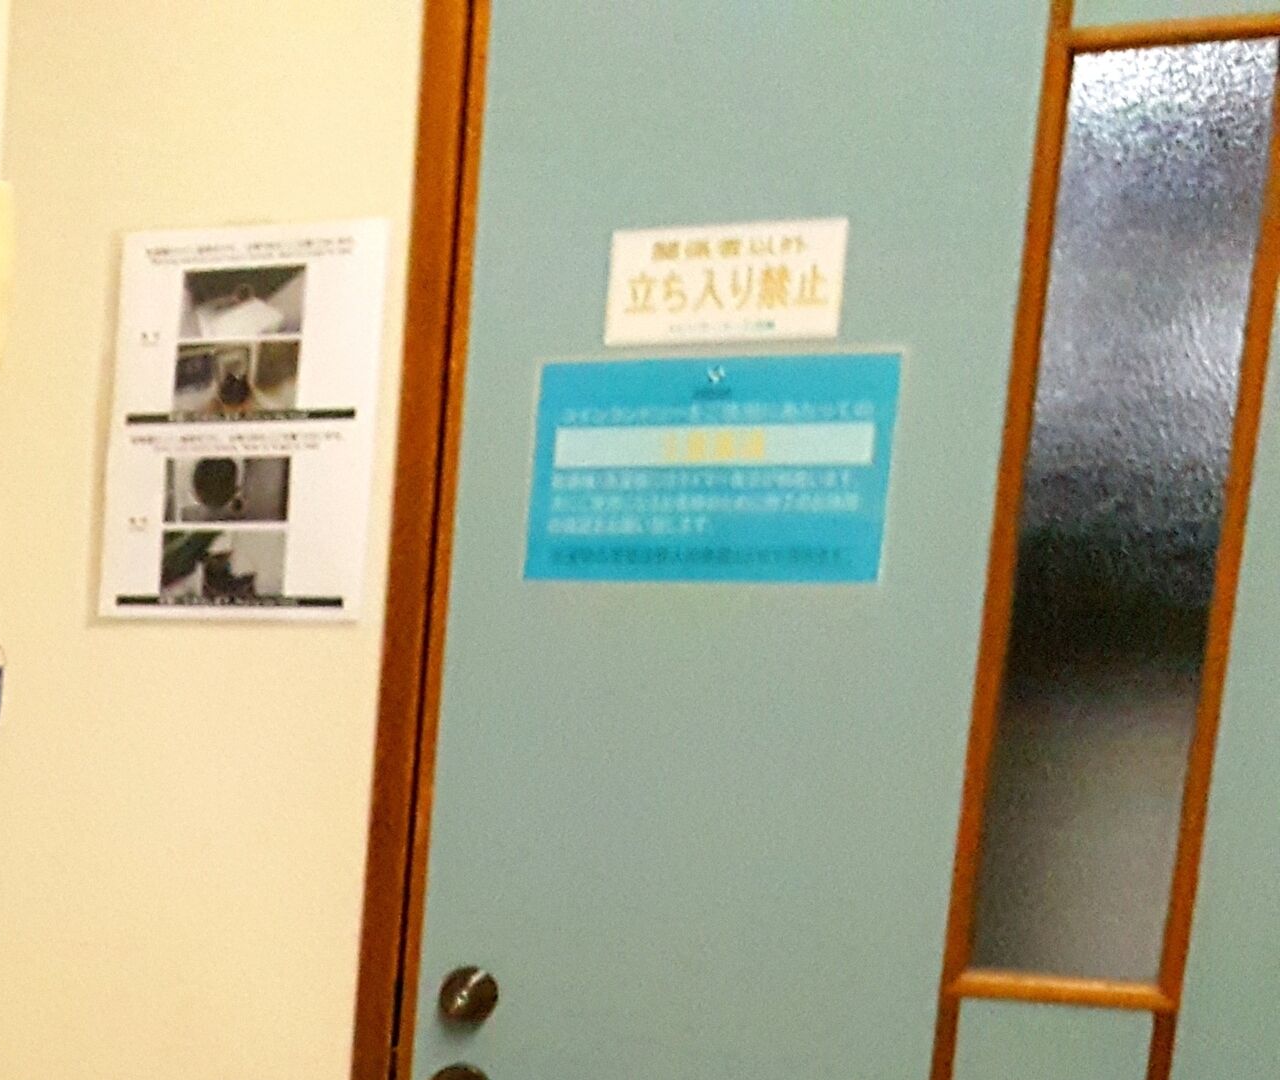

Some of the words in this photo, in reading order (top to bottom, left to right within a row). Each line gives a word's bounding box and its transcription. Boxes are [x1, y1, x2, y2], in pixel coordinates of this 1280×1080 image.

[625, 264, 829, 315] 立ち入り禁止
